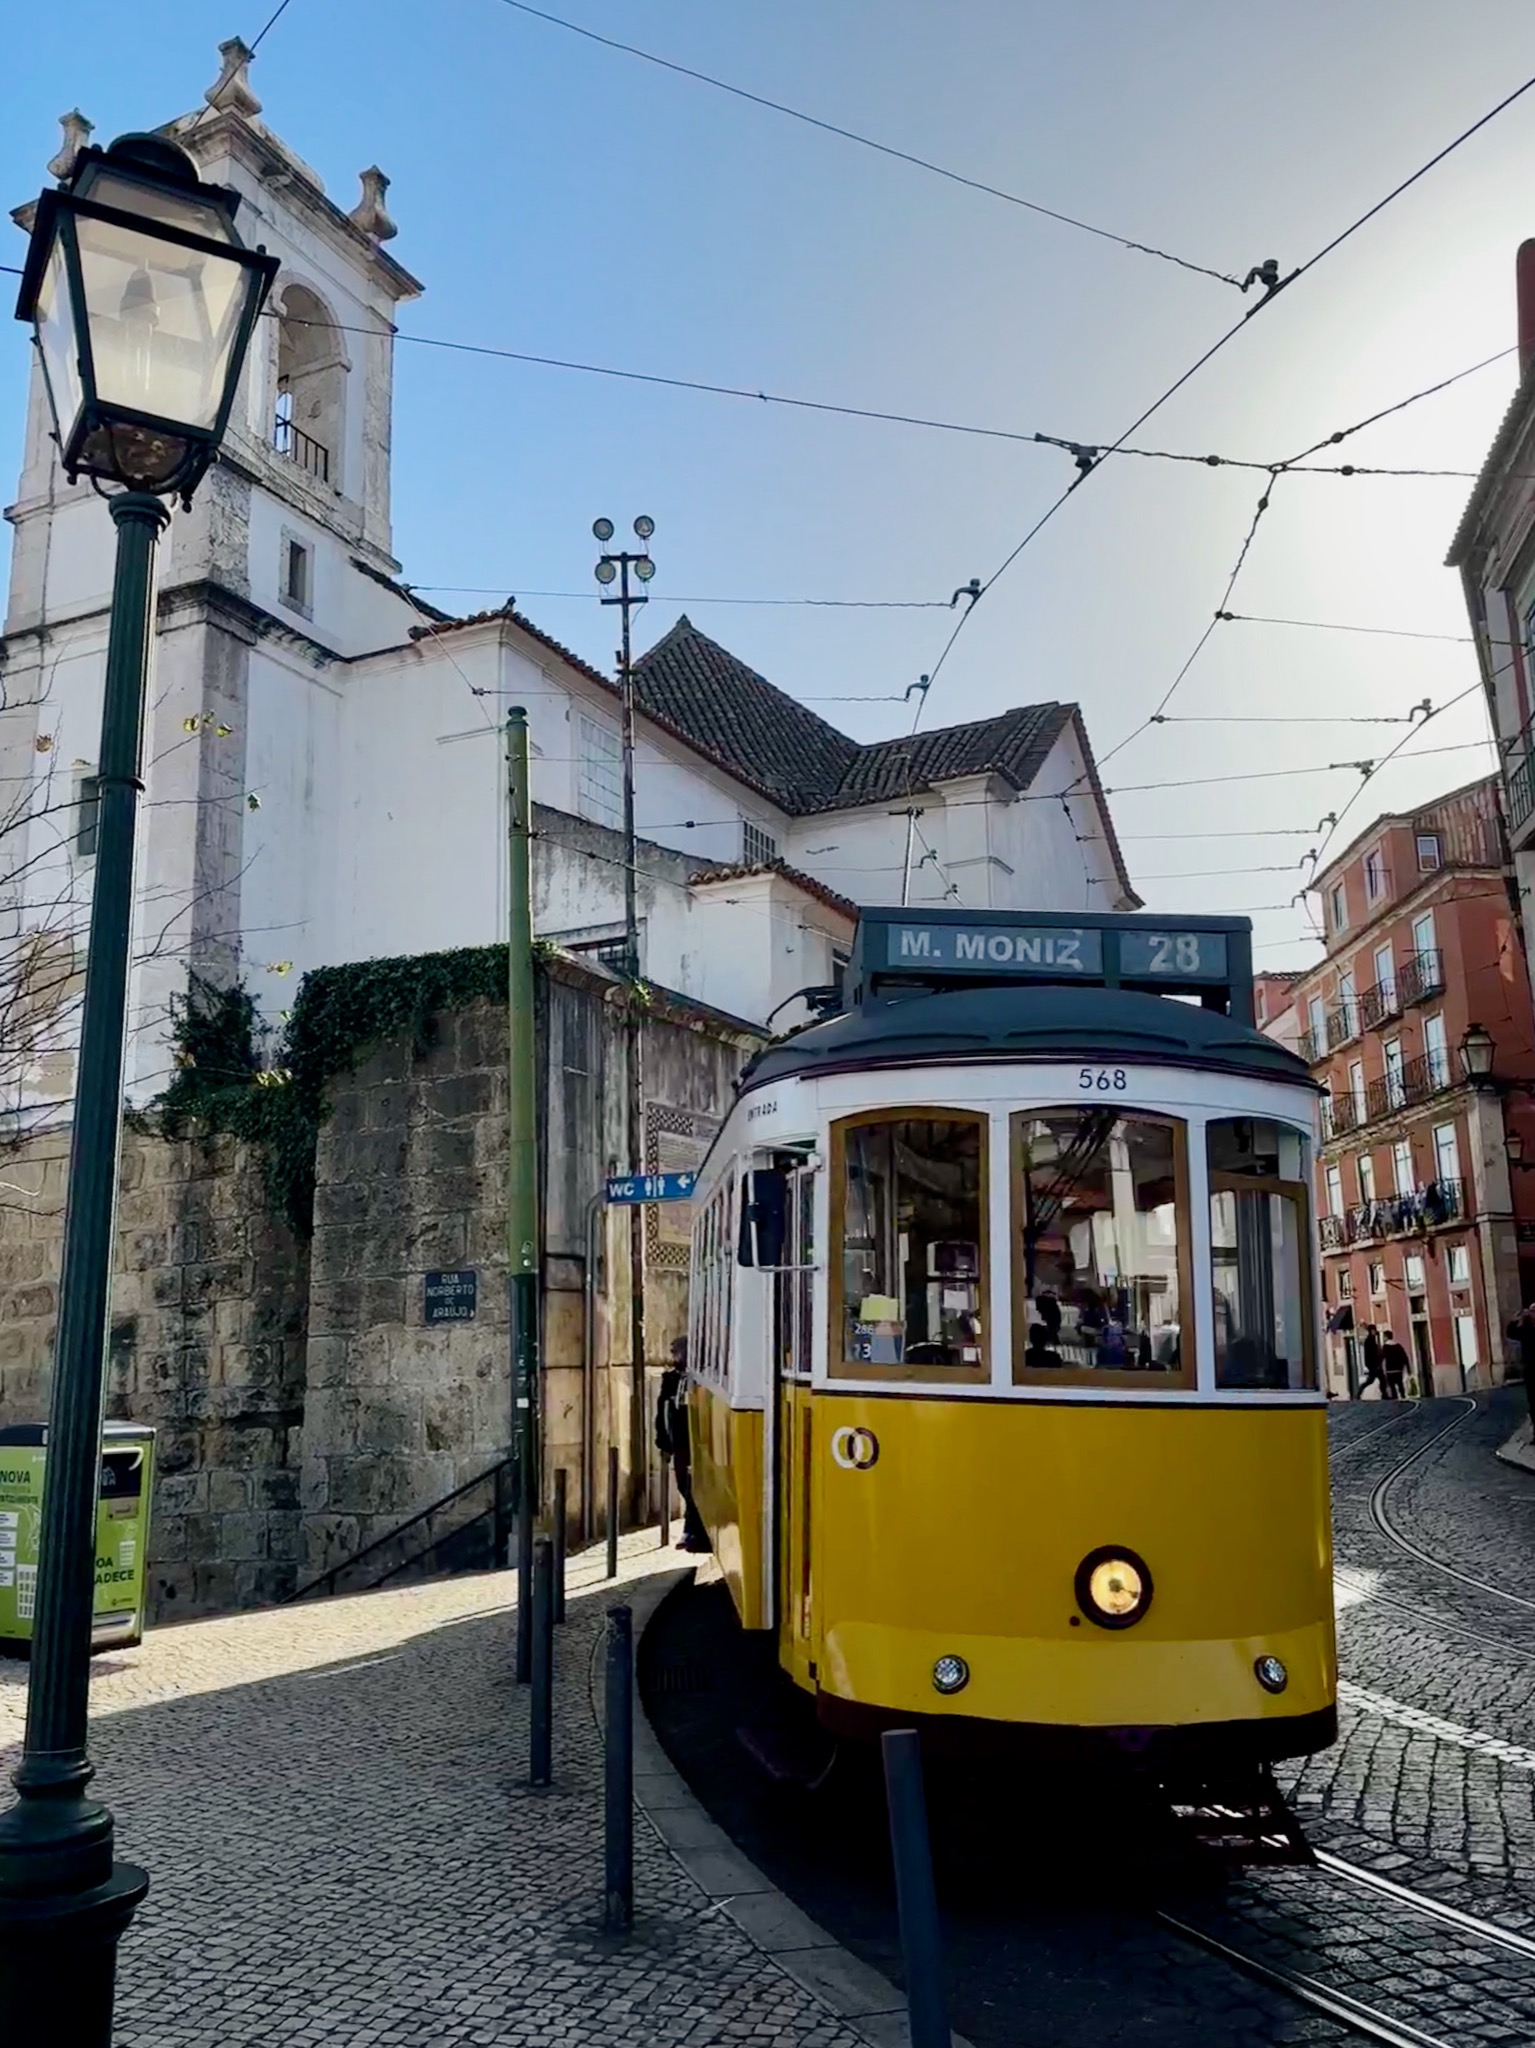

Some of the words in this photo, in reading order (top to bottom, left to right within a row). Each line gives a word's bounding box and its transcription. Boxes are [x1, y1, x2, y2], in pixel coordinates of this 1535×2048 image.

[901, 930, 941, 957] M.
[955, 933, 1082, 970] MONIZ
[1149, 934, 1200, 973] 28
[1079, 1068, 1126, 1090] 568
[609, 1182, 635, 1198] WC
[441, 1273, 460, 1285] RUA
[426, 1284, 475, 1297] NORBERTO
